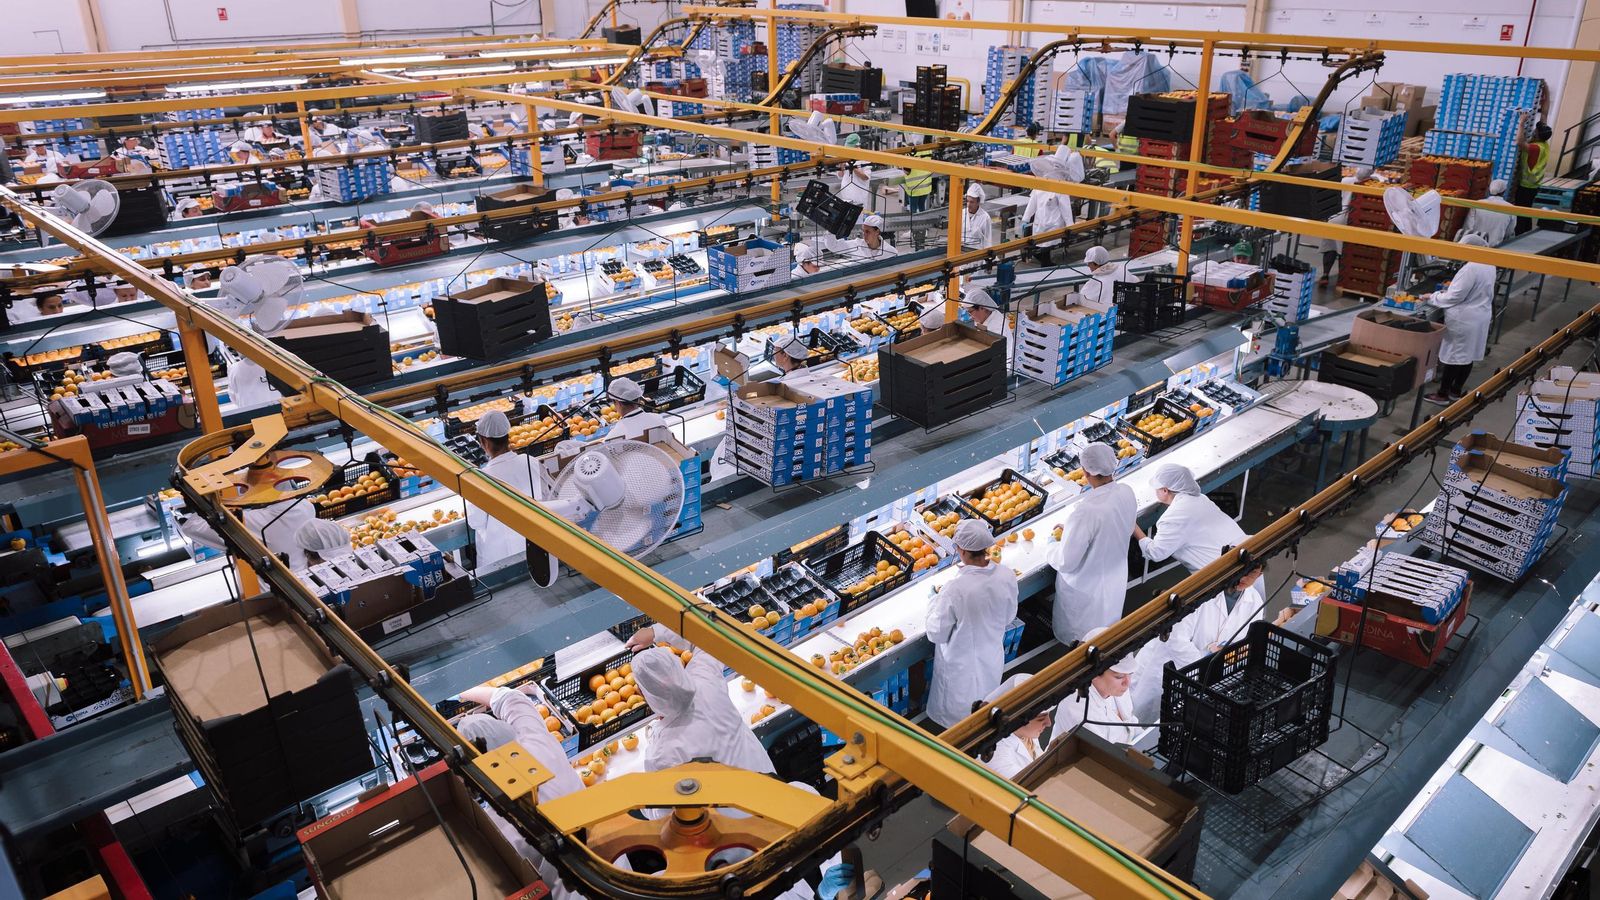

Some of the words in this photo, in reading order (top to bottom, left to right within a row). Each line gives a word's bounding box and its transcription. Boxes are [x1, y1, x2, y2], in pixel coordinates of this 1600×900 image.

[1527, 402, 1551, 410] MDINA
[65, 709, 88, 722] MDINA
[303, 806, 355, 837] SUNGOLD
